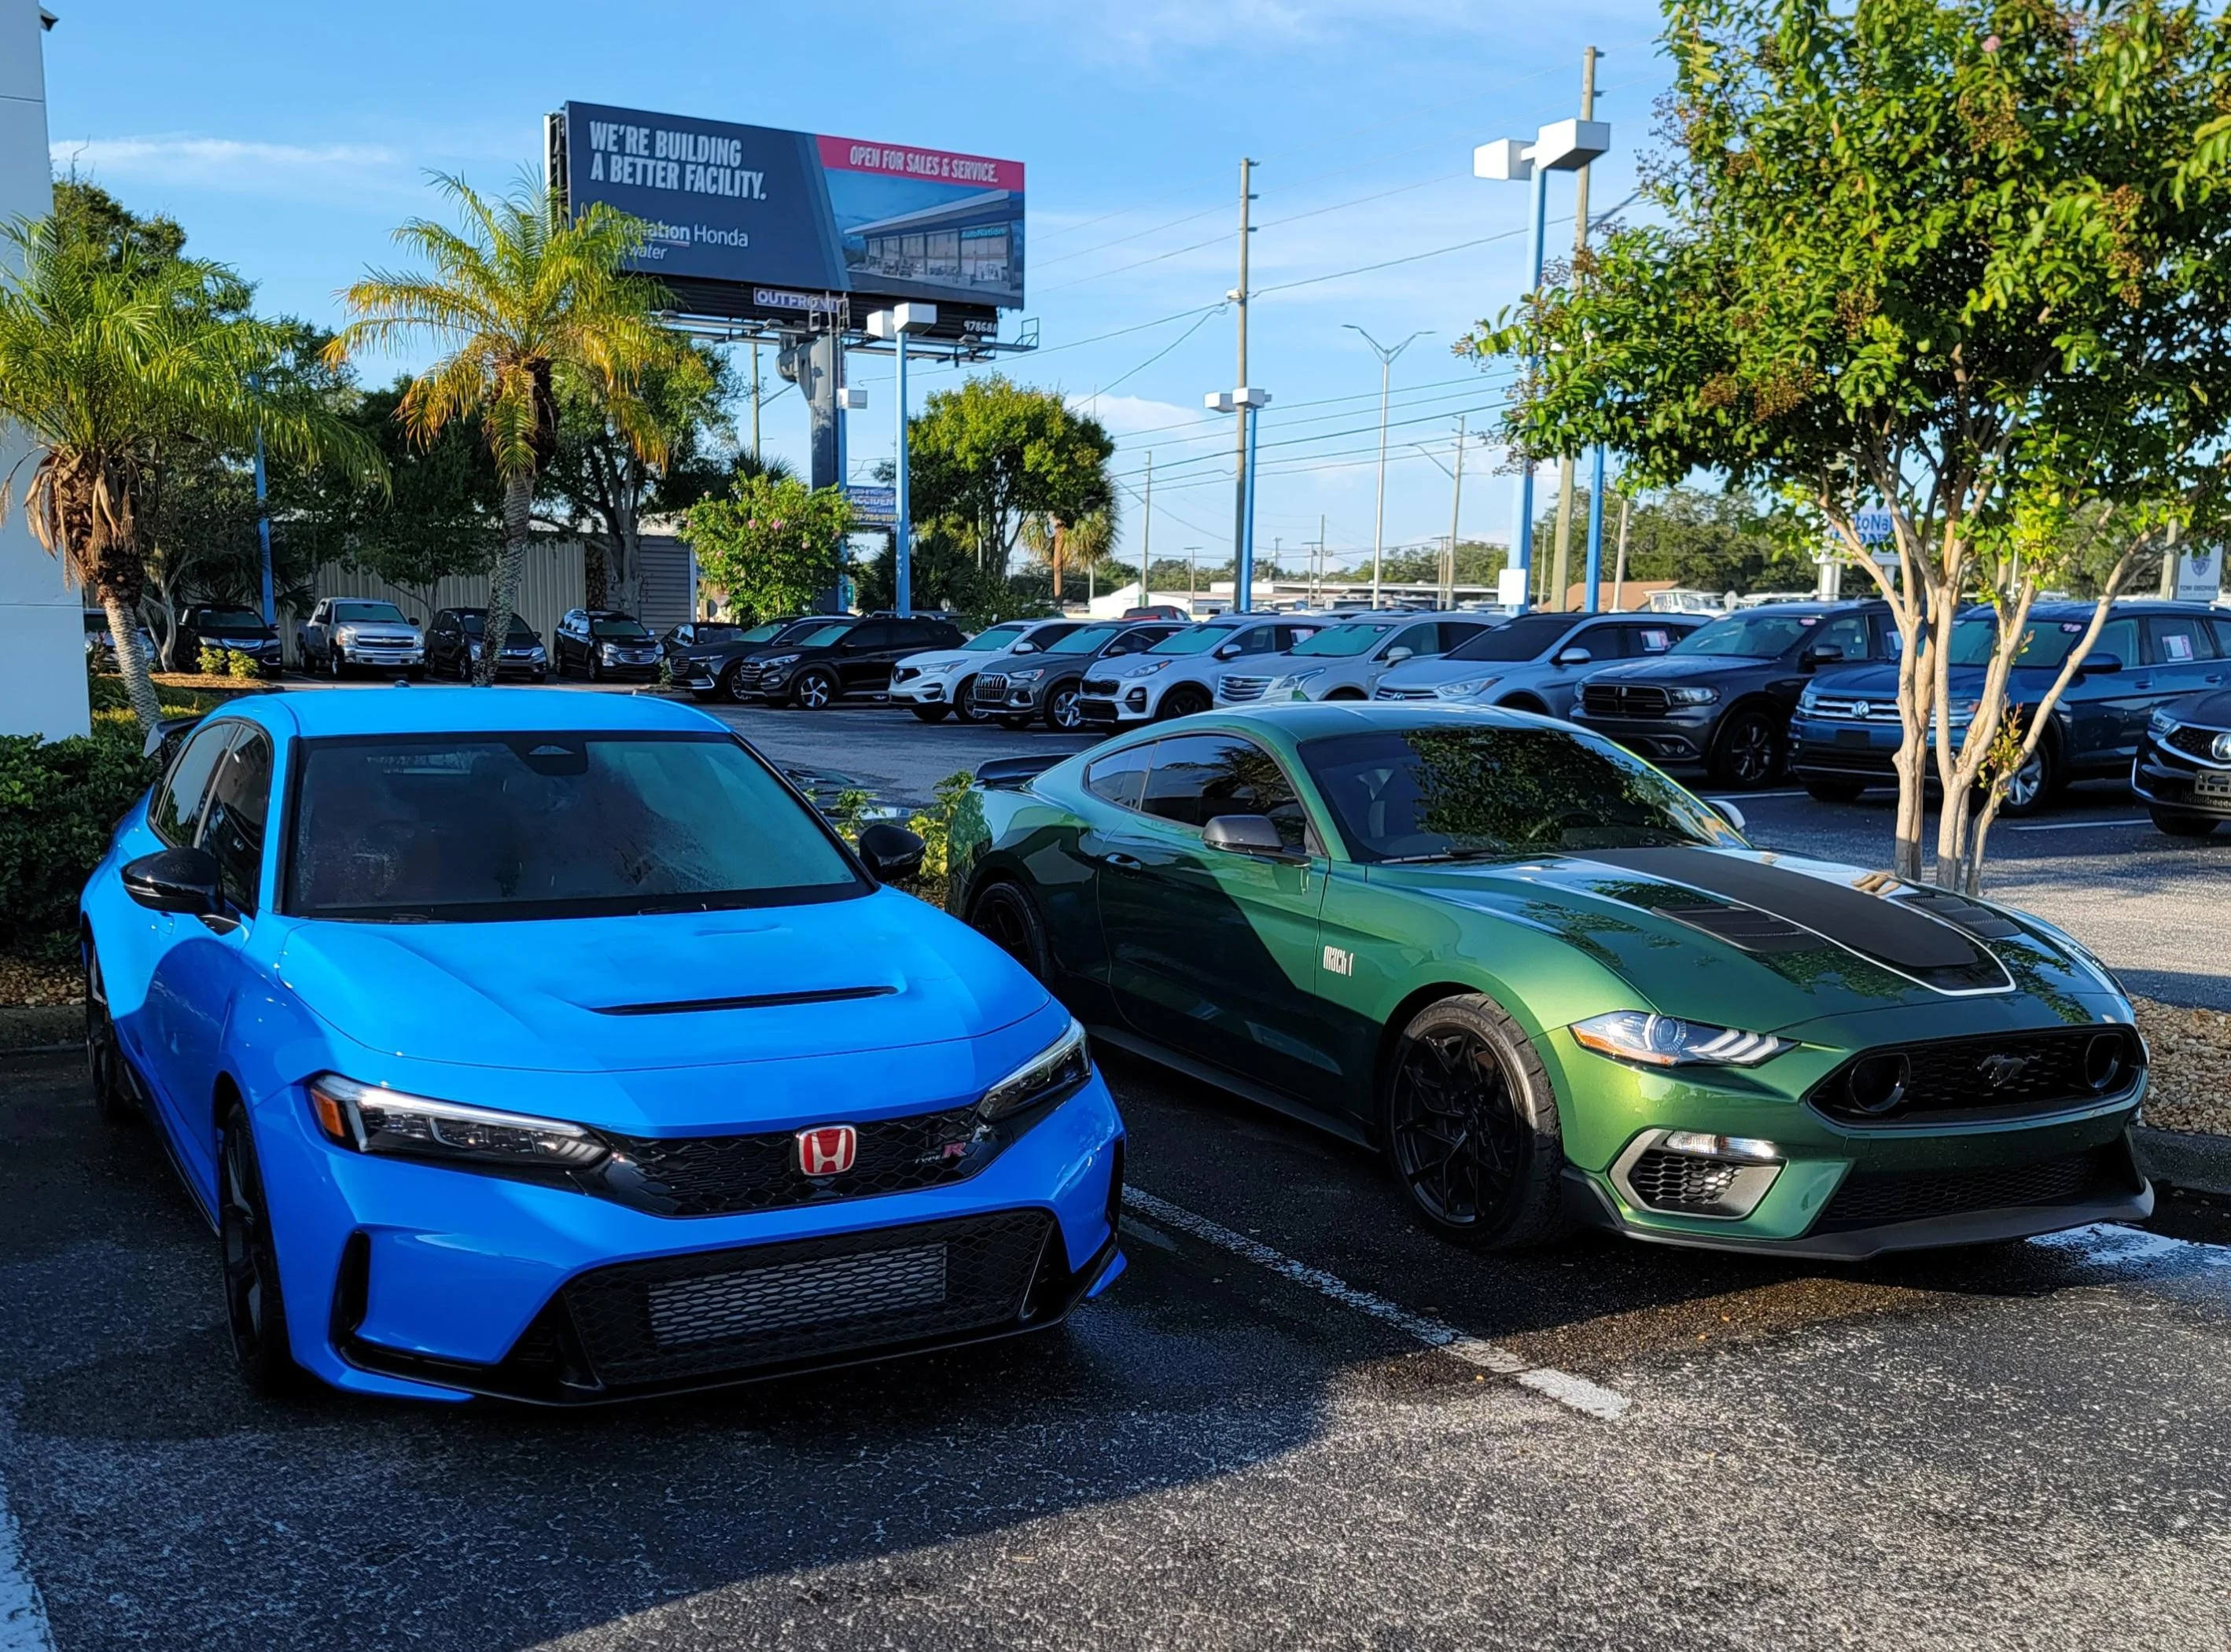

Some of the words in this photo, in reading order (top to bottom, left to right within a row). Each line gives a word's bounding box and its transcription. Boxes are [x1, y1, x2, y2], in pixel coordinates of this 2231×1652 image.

[590, 121, 650, 156] WE'RE
[655, 130, 742, 167] BUILDING
[590, 152, 605, 181] A
[609, 154, 680, 189] BETTER
[684, 164, 767, 201] FACILITY.
[849, 145, 881, 168] OPEN
[882, 150, 904, 171] FOR
[906, 153, 941, 176] SALES
[941, 157, 950, 177] &
[952, 158, 999, 182] SERVICE.
[694, 223, 749, 247] Honda
[757, 290, 838, 311] OUTFRONT
[852, 495, 895, 506] ACCIDEN
